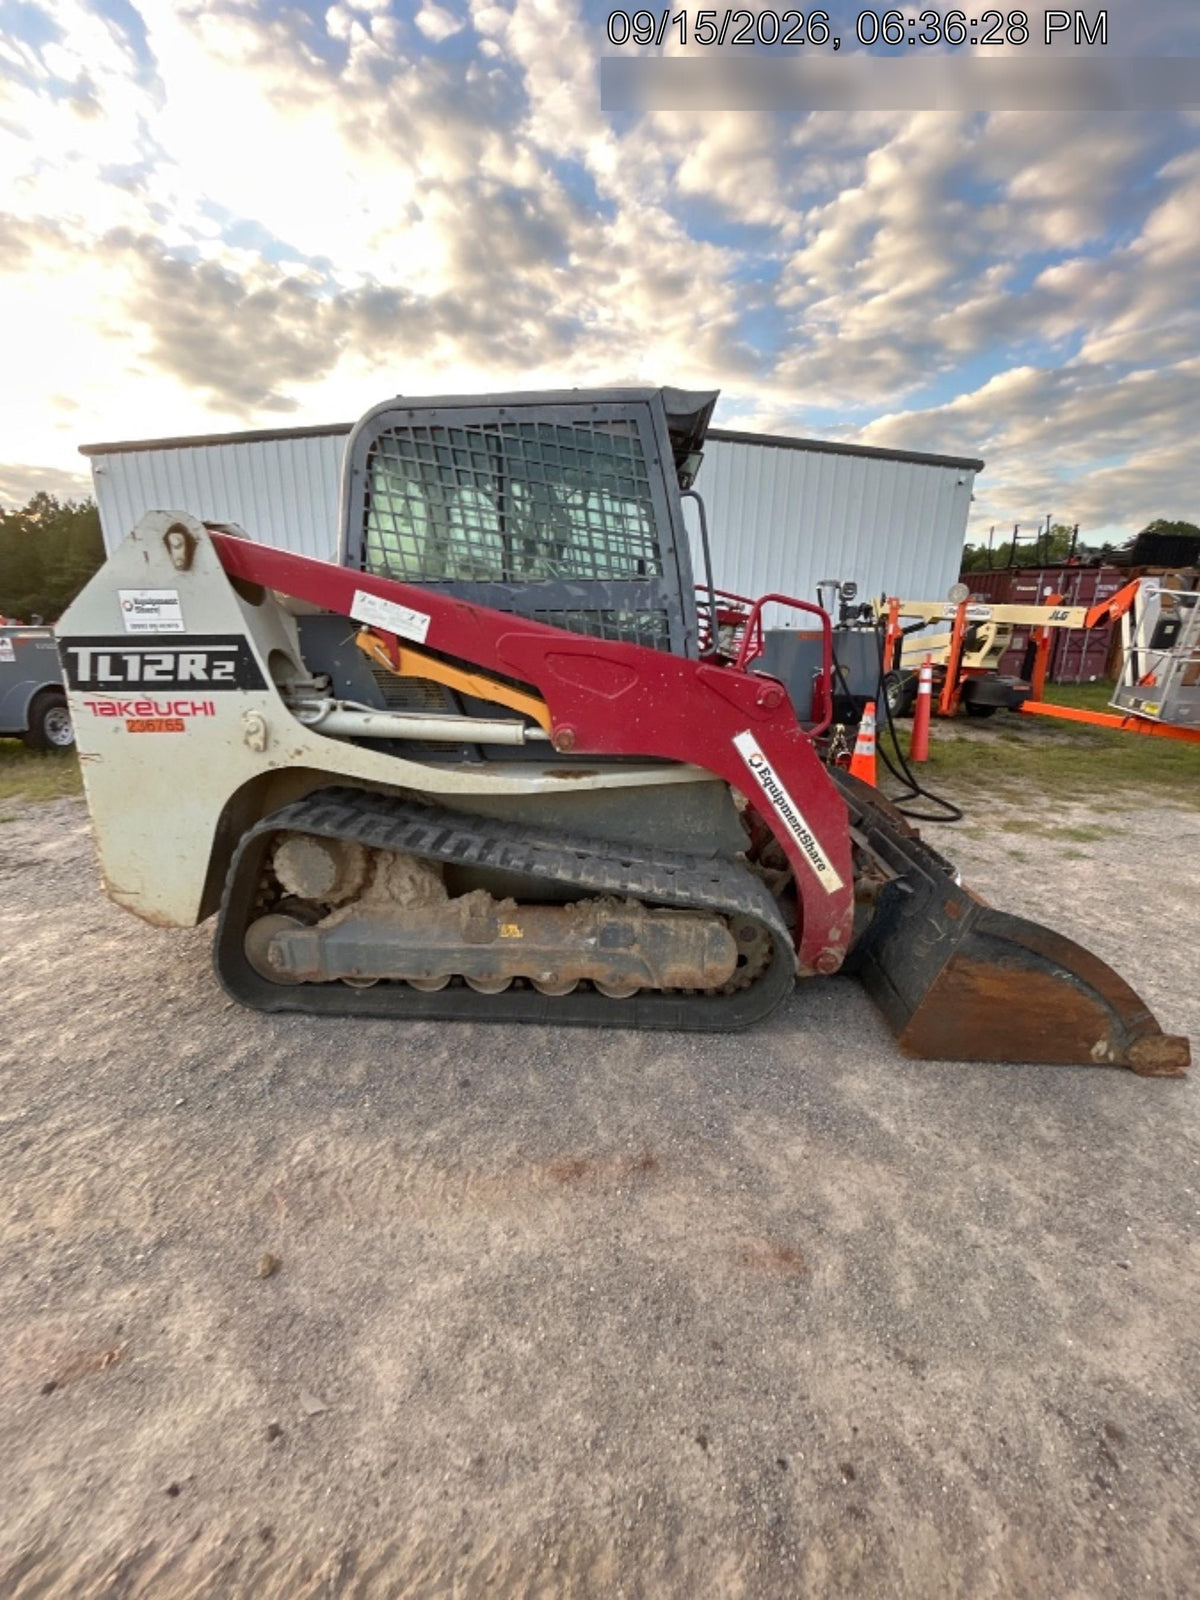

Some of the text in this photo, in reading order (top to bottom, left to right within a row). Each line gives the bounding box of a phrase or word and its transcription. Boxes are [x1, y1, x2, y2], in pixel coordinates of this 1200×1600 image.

[1048, 610, 1070, 621] JLG
[67, 645, 239, 682] TL12R2
[757, 766, 827, 873] EquipmentShare
